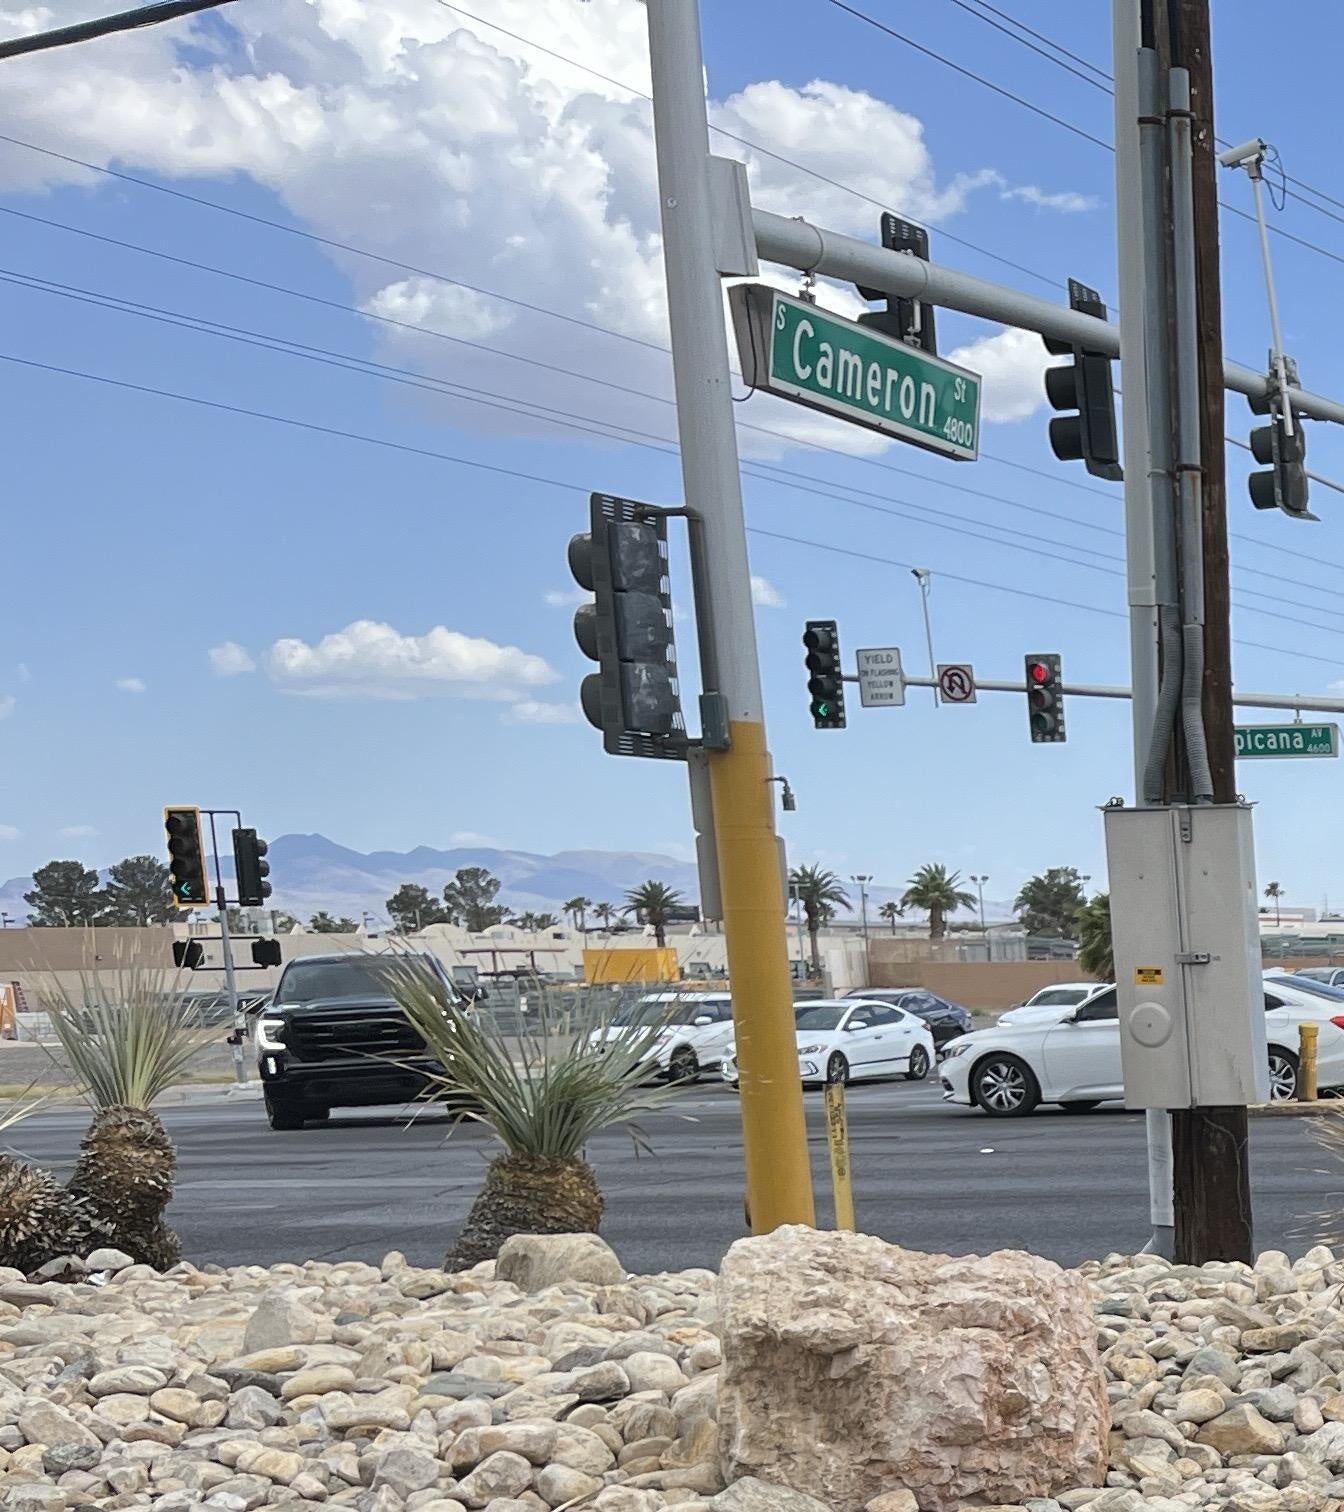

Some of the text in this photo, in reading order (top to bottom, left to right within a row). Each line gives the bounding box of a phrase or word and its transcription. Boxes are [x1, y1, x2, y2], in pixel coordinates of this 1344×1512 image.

[776, 304, 786, 330] S
[793, 320, 936, 427] Cameron
[953, 378, 967, 403] St
[943, 416, 973, 446] 4800
[864, 654, 893, 664] YIELD
